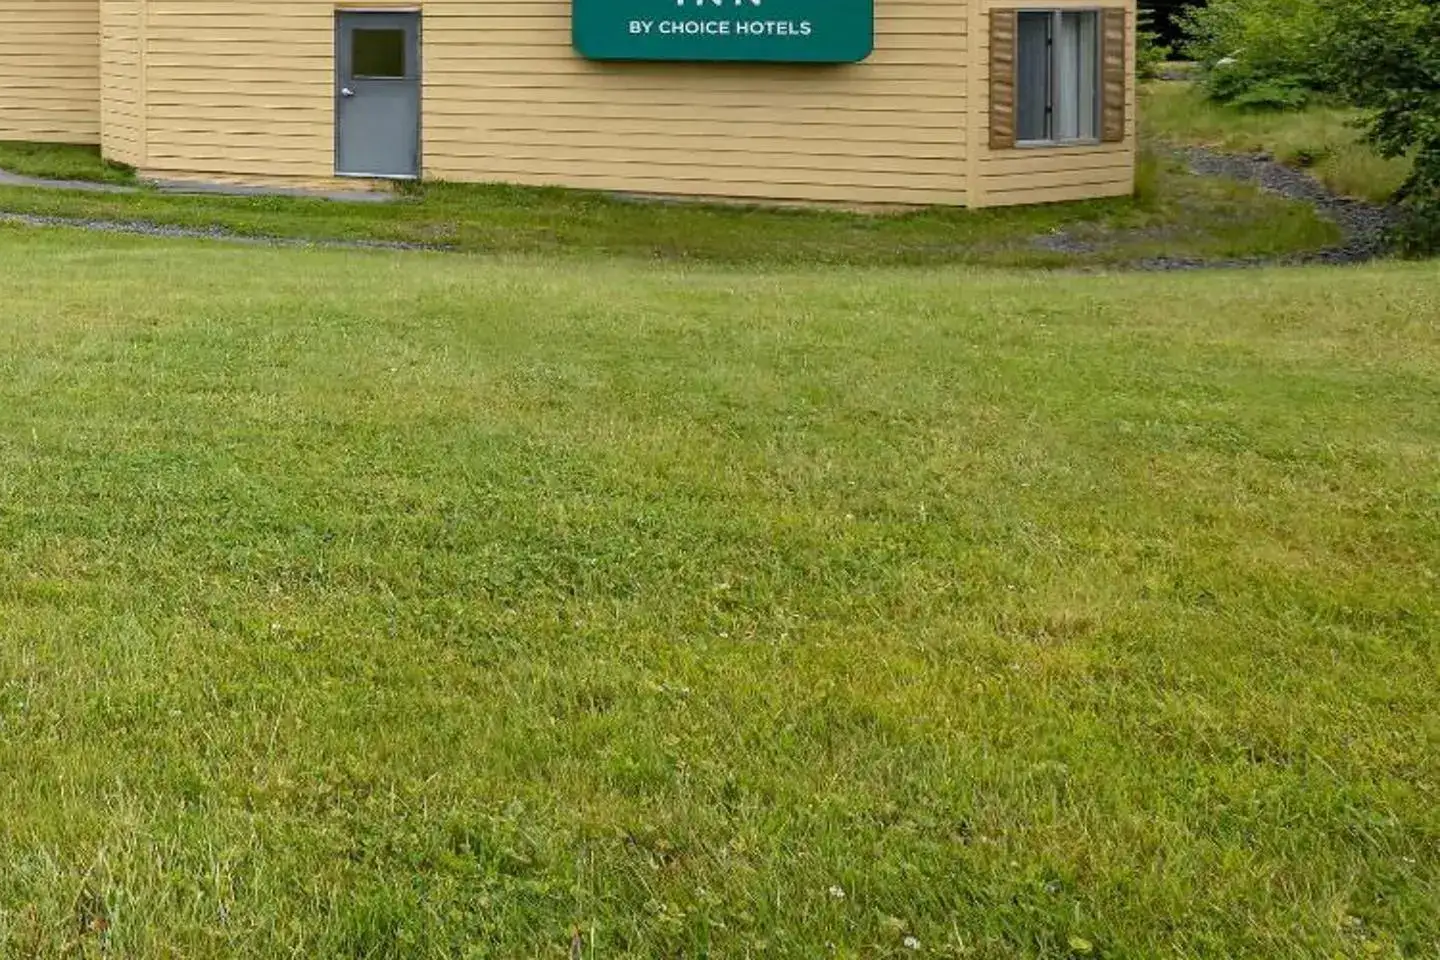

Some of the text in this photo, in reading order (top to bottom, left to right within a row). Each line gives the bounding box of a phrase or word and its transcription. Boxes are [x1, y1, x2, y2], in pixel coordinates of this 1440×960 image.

[628, 21, 812, 36] BY CHOICE HOTELS
